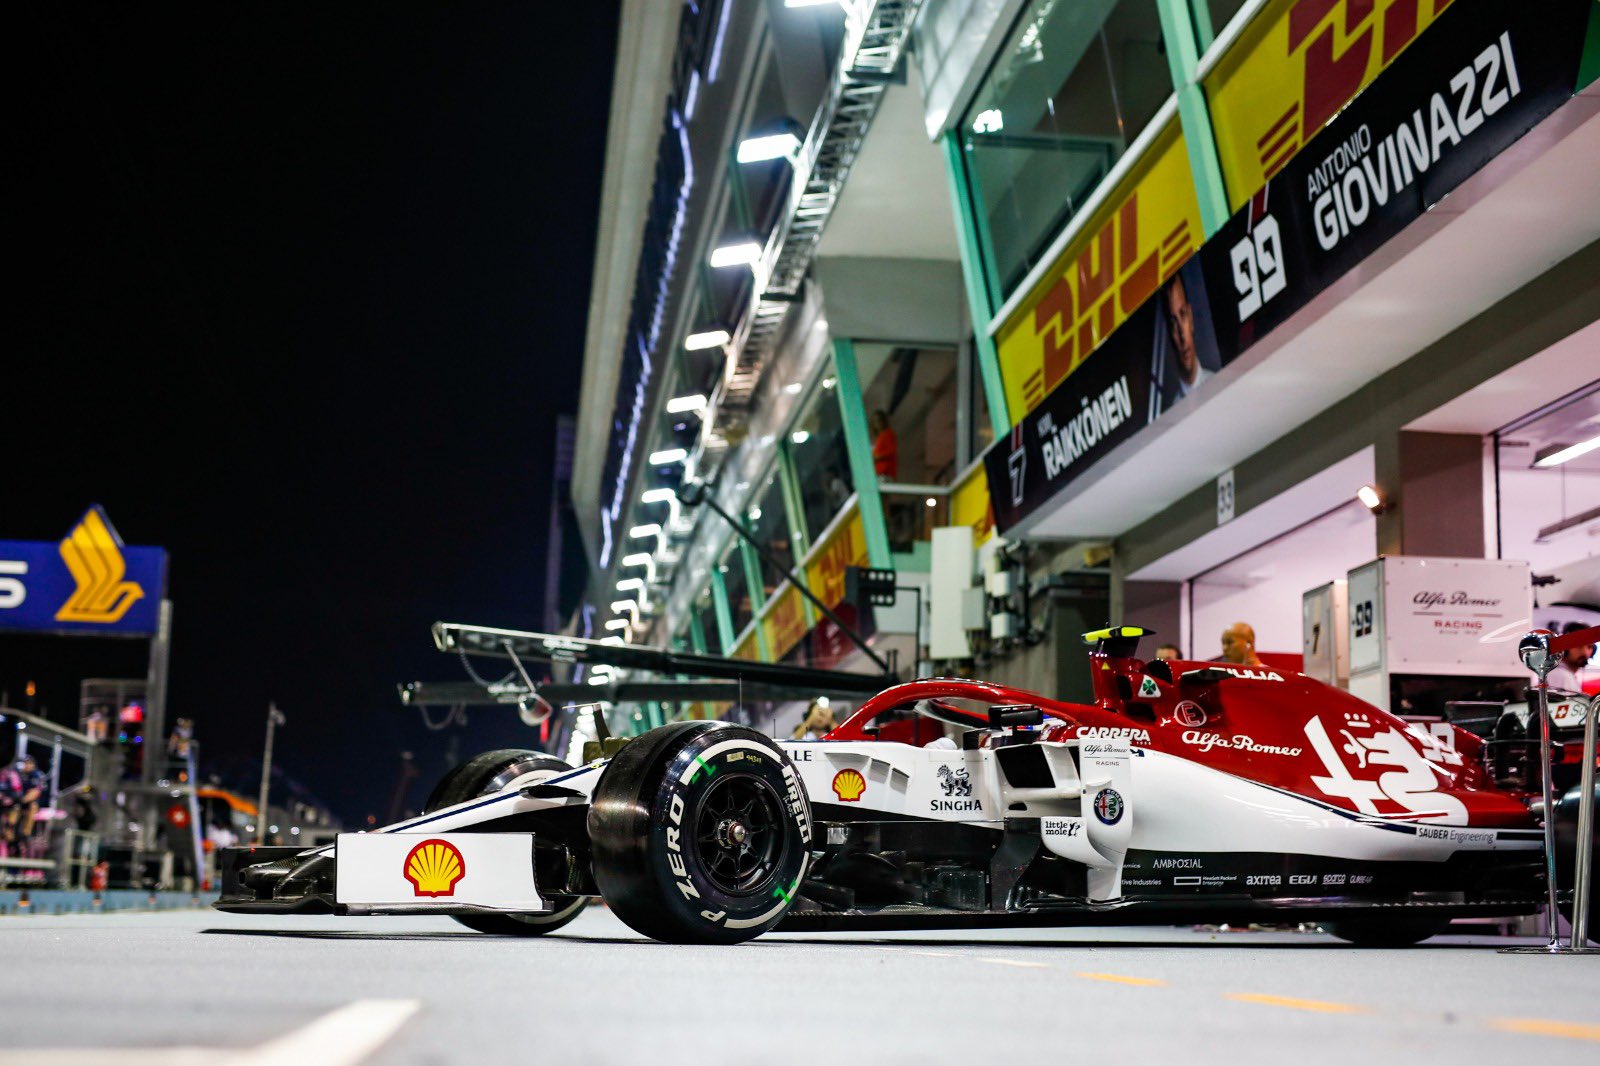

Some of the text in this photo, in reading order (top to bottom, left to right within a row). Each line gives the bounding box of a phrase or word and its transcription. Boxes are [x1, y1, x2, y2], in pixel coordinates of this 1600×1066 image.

[1313, 30, 1521, 251] GIOVINAZZI
[1307, 124, 1372, 201] ANTONIO
[1230, 214, 1287, 323] 99
[1042, 374, 1132, 481] RÄIKKÖNEN
[1413, 591, 1446, 610] Alfa
[1434, 620, 1482, 629] RACING
[1076, 726, 1151, 742] CARRERA
[1182, 730, 1302, 756] Alfa Romeo
[1084, 744, 1128, 755] Alfa Romeo
[782, 764, 812, 844] PIRELLI
[930, 799, 983, 811] SINGHA
[1045, 821, 1068, 829] little
[1418, 828, 1494, 845] SAUBER Engineering
[667, 792, 701, 901] ZERO
[1133, 877, 1162, 886] Industries
